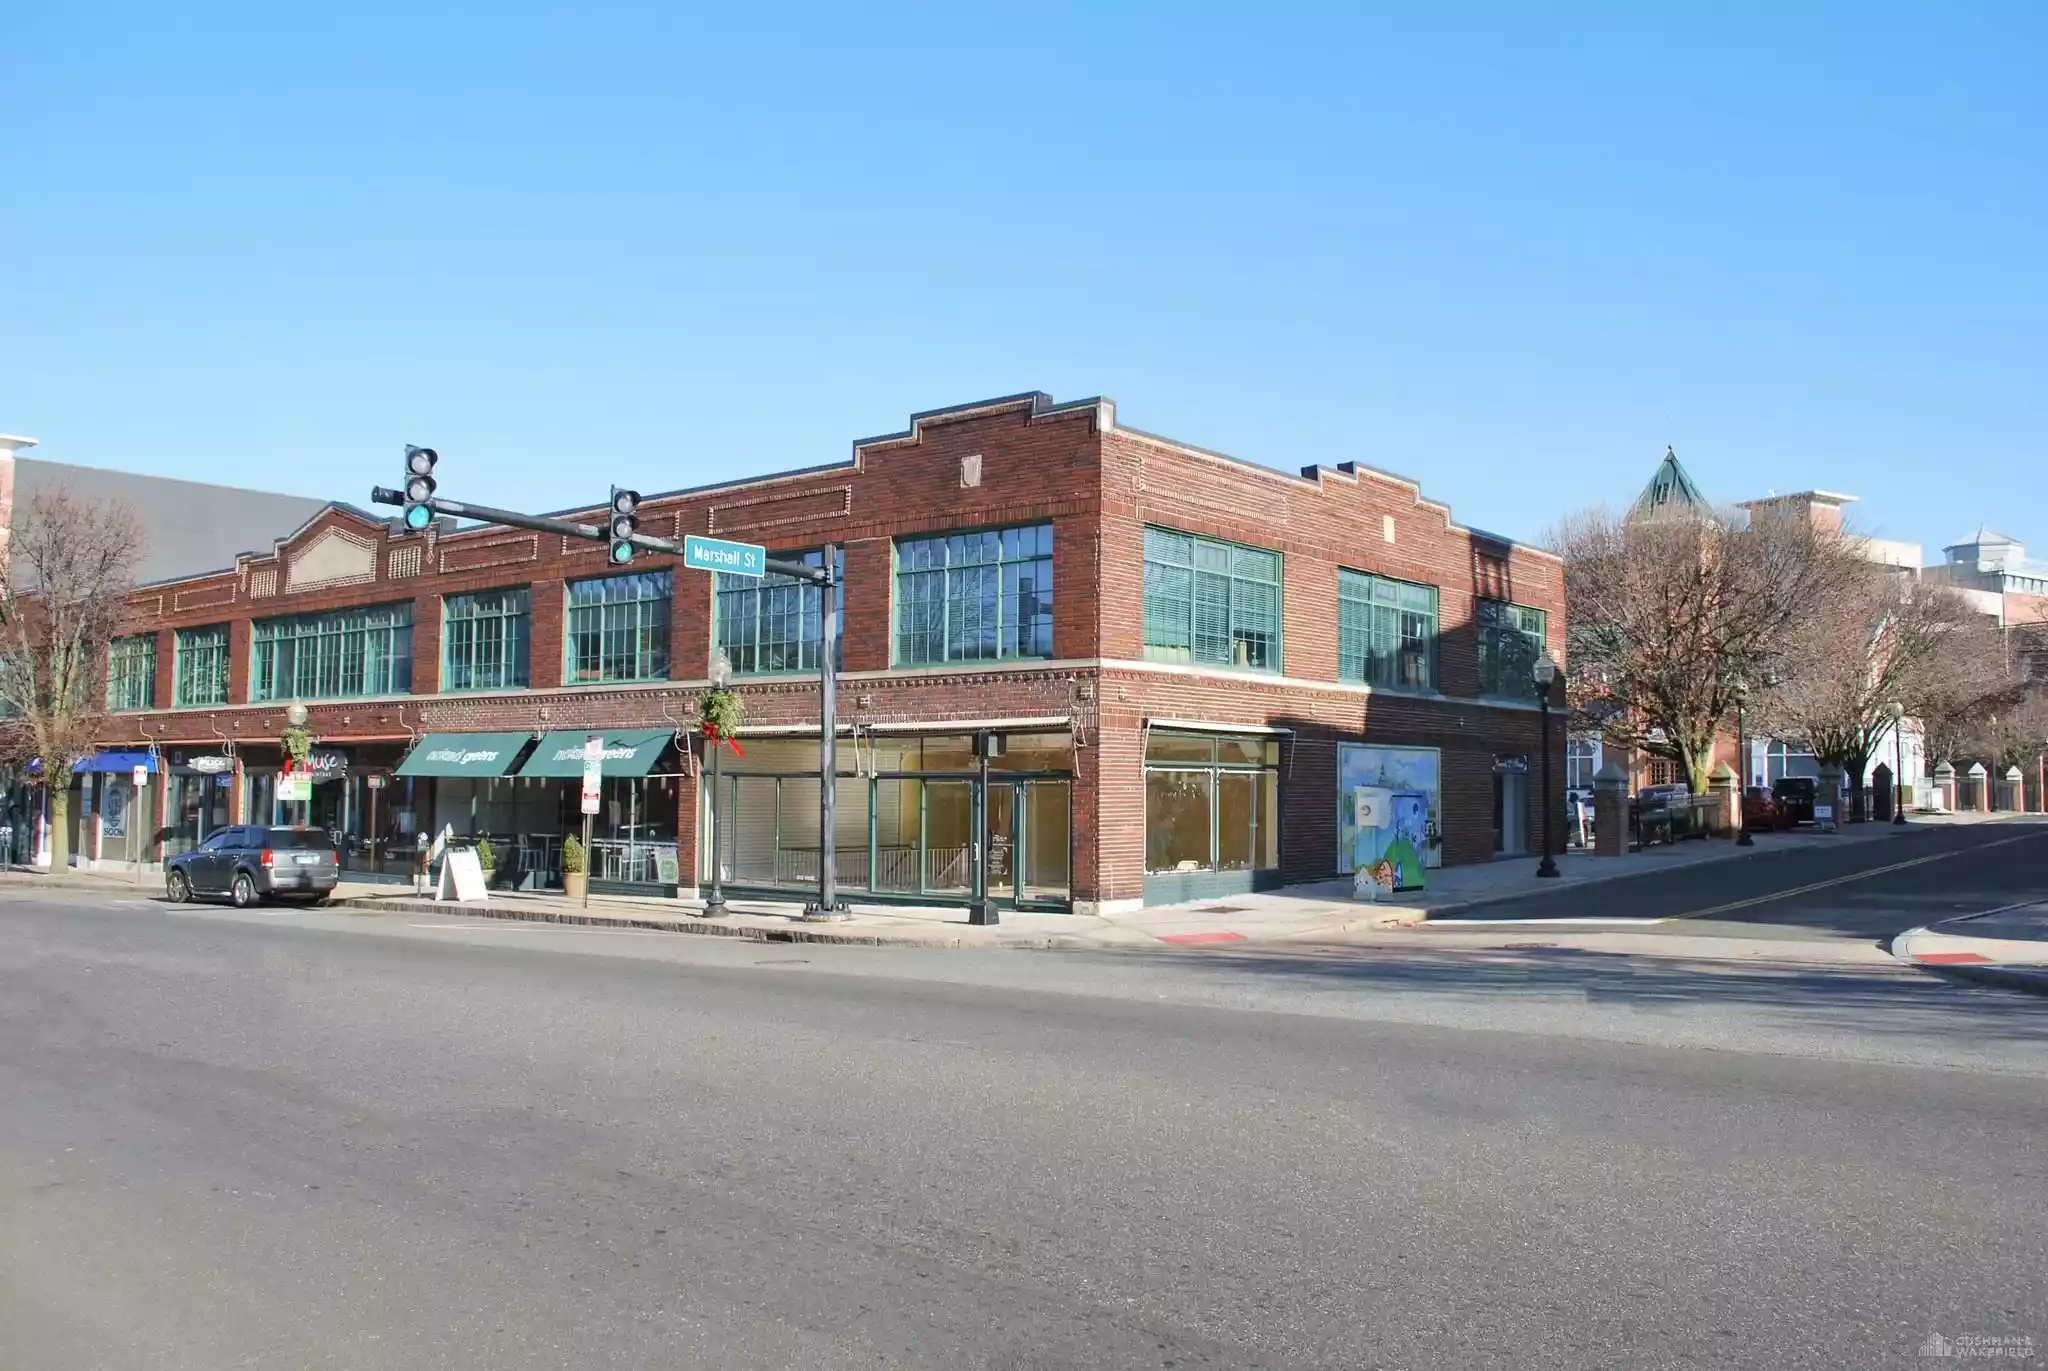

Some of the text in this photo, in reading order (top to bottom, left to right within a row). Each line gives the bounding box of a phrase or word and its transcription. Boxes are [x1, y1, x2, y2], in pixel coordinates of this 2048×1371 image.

[694, 544, 756, 568] Marshall St
[601, 748, 639, 760] reens
